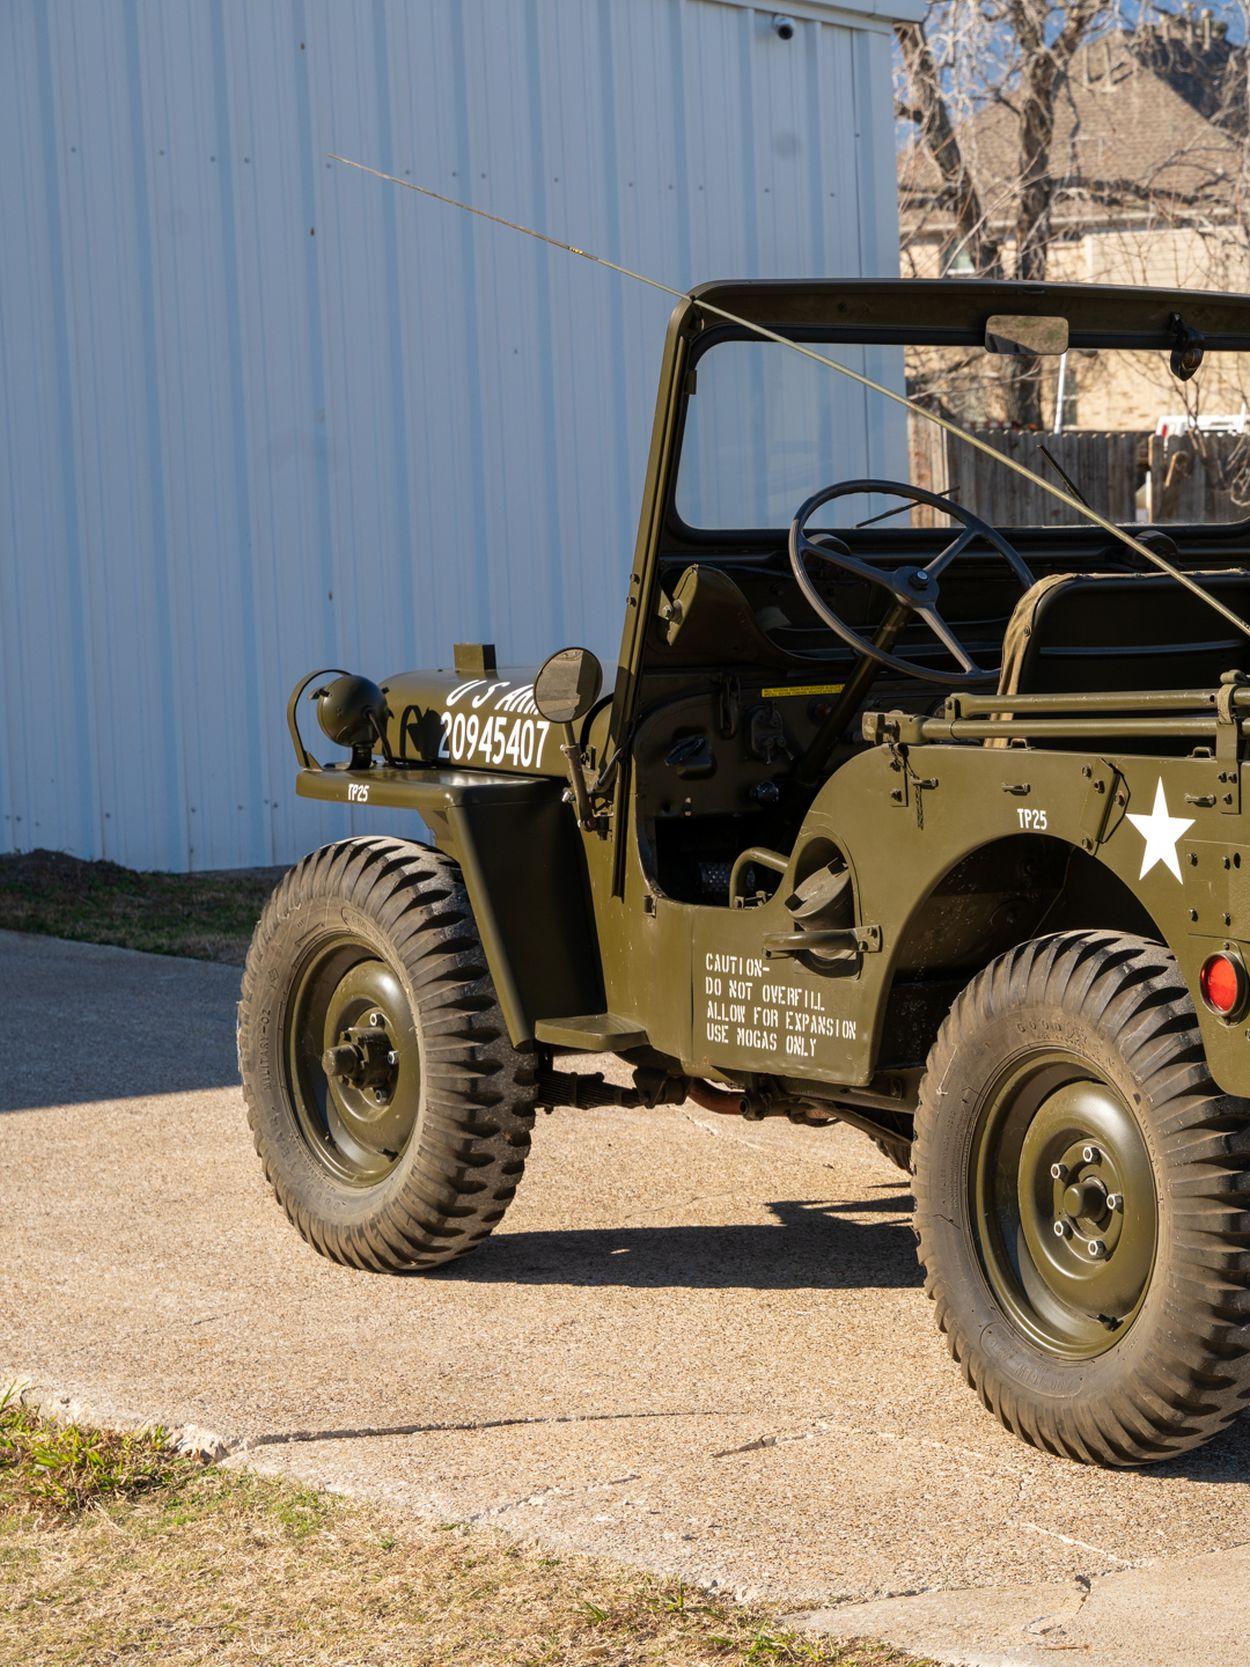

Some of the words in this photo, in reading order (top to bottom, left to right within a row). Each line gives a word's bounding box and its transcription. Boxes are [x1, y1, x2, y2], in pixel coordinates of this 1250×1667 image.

[438, 711, 550, 769] 20945407
[348, 783, 370, 802] TP25
[1017, 808, 1048, 831] TP25
[705, 976, 722, 996] DO
[729, 980, 753, 1000] NOT
[762, 985, 825, 1011] OVERFILL
[706, 1000, 745, 1023] ALLOW
[753, 1007, 779, 1028] FOR
[786, 1011, 857, 1040] EXPANSION
[706, 1023, 729, 1044] USE
[736, 1028, 778, 1051] MOGAS
[786, 1035, 817, 1057] ONLY
